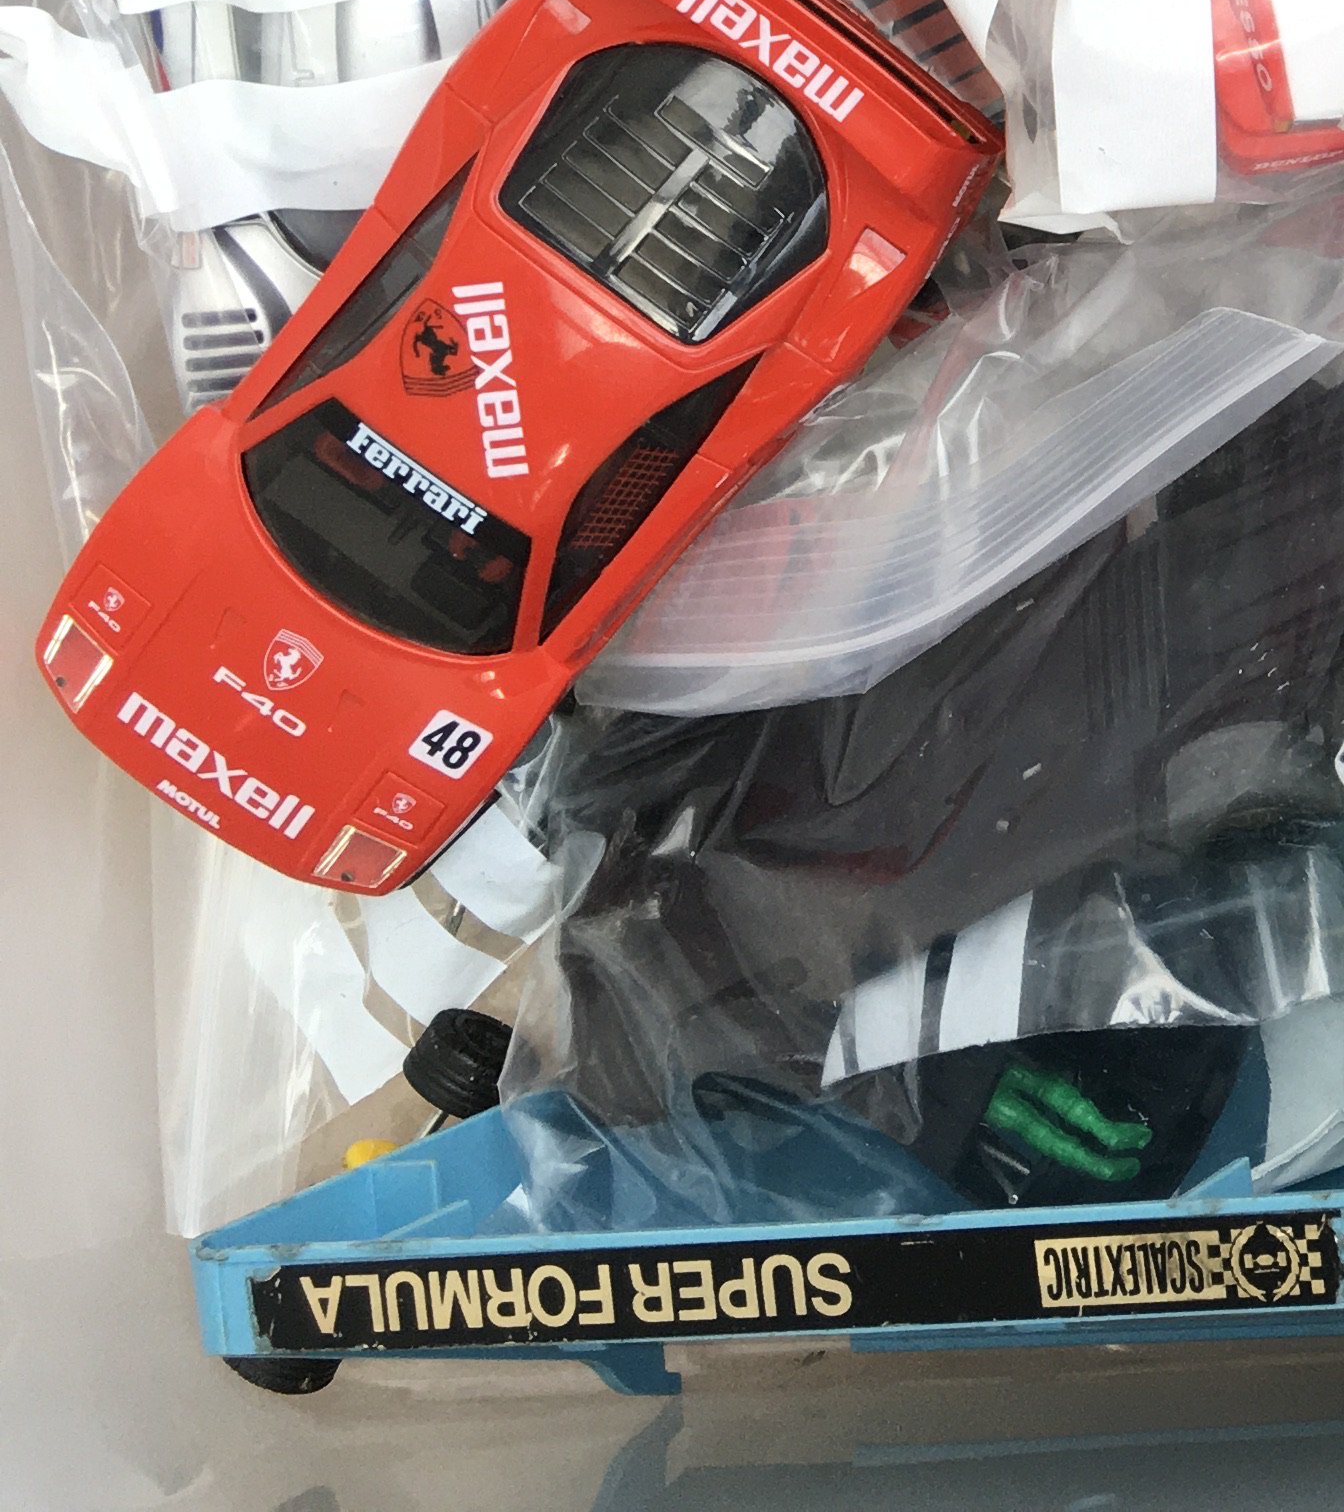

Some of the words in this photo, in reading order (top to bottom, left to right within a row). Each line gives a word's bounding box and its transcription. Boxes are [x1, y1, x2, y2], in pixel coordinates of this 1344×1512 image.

[451, 281, 530, 479] maxell
[346, 421, 488, 535] Ferrari
[87, 599, 122, 633] F40
[211, 665, 308, 738] F40
[116, 691, 316, 840] maxell
[421, 719, 483, 770] 48
[156, 779, 222, 830] MOTUL
[373, 806, 415, 831] F40
[300, 1262, 613, 1336] FORMULA
[630, 1251, 854, 1333] SUPER
[1044, 1236, 1204, 1302] SCALEXTRIC
